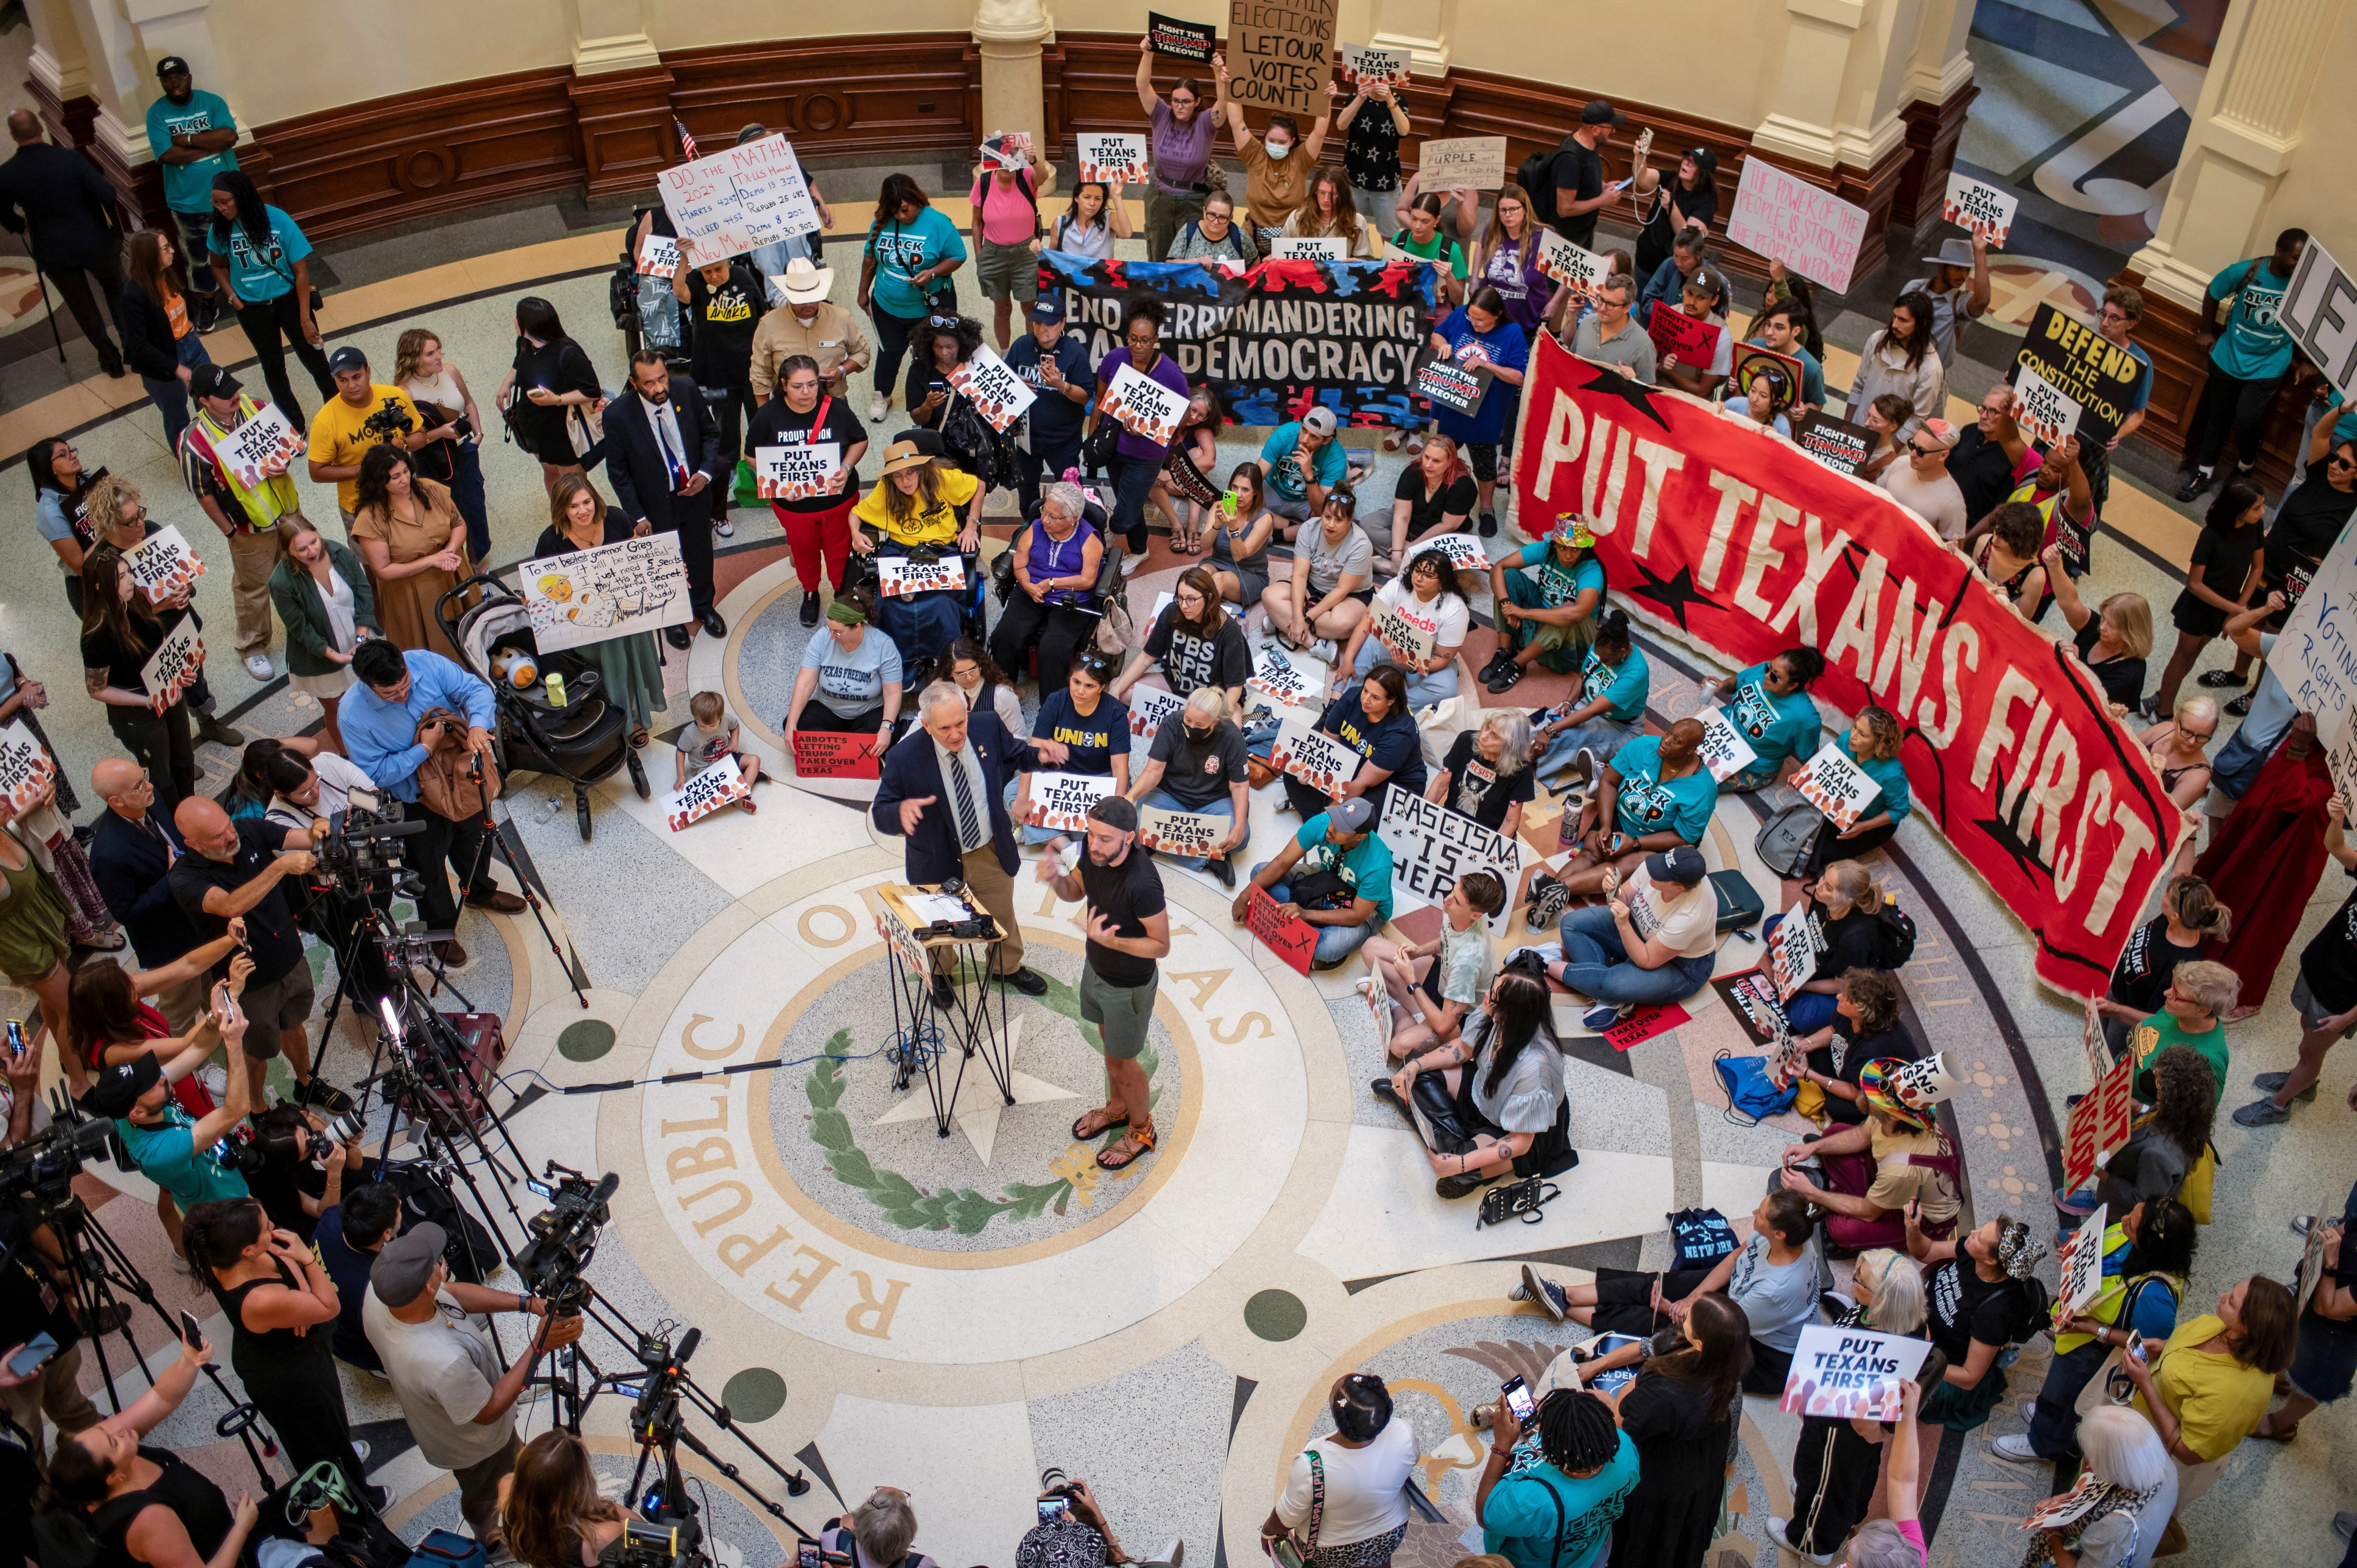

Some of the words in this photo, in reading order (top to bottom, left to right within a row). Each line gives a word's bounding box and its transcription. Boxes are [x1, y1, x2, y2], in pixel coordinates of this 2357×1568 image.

[1159, 23, 1185, 36] FIGHT
[1186, 30, 1205, 40] THE
[1232, 2, 1330, 40] ELECTIONS
[1157, 42, 1205, 58] TAKEOVER
[1242, 32, 1282, 55] LET
[1286, 40, 1326, 65] OUR
[1249, 58, 1318, 90] VOTES
[1230, 77, 1309, 111] COUNT!
[1090, 148, 1136, 158] TEXANS
[1101, 138, 1124, 147] PUT
[1427, 141, 1469, 152] TEXAS
[668, 169, 694, 190] DO
[701, 164, 724, 177] THE
[732, 141, 787, 170] MATH!
[1099, 157, 1131, 167] FIRST
[1453, 165, 1480, 175] Stop
[1480, 153, 1495, 162] not
[683, 183, 716, 202] 2024
[768, 180, 776, 190] 13
[781, 176, 797, 187] 32%
[1973, 186, 1997, 201] PUT
[778, 194, 789, 204] 25
[1747, 162, 1772, 195] THE
[1777, 177, 1818, 219] POWER
[1819, 201, 1837, 225] OF
[1838, 207, 1860, 240] THE
[1958, 191, 2004, 218] TEXANS
[677, 204, 713, 221] HARRIS
[776, 215, 782, 224] 8
[788, 208, 805, 219] 20%
[1962, 203, 1995, 224] FIRST
[686, 221, 719, 239] ALLRED
[782, 226, 794, 237] 30
[799, 222, 814, 231] 80%
[1739, 189, 1786, 226] PEOPLE
[1789, 214, 1799, 235] IS
[1802, 219, 1859, 266] STRONGER
[1771, 226, 1804, 249] THAN
[1550, 246, 1595, 277] TEXANS
[1563, 244, 1586, 261] PUT
[1732, 219, 1751, 246] THE
[1754, 230, 1797, 267] PEOPLE
[1800, 253, 1811, 274] IN
[1813, 257, 1849, 293] POWER
[1554, 259, 1586, 280] FIRST
[1066, 288, 1121, 330] END
[1157, 299, 1424, 341] ERRYMANDERING,
[1177, 334, 1419, 384] DEMOCRACY
[2045, 310, 2138, 385] DEFEND
[992, 364, 1015, 384] PUT
[1429, 361, 1459, 376] FIGHT
[1459, 371, 1479, 386] THE
[2064, 353, 2103, 389] THE
[972, 376, 1005, 406] FIRST
[975, 362, 1017, 406] TEXANS
[1138, 380, 1164, 399] PUT
[1419, 382, 1469, 409] TAKEOVER
[1123, 382, 1171, 417] TEXANS
[1124, 397, 1159, 421] FIRST
[234, 422, 281, 459] TEXANS
[239, 420, 264, 442] PUT
[778, 431, 804, 443] PROUD
[248, 435, 282, 464] FIRST
[784, 451, 812, 461] PUT
[770, 460, 827, 471] TEXANS
[780, 471, 818, 482] FIRST
[524, 564, 541, 576] To
[544, 561, 557, 572] my
[558, 553, 589, 566] bestest
[591, 546, 623, 562] governor
[573, 563, 587, 576] It
[591, 559, 606, 570] will
[612, 556, 624, 565] be
[595, 571, 617, 586] just
[620, 564, 641, 575] need
[647, 558, 655, 570] 5
[595, 581, 612, 593] may
[613, 575, 631, 585] this
[634, 571, 644, 580] be
[647, 568, 660, 576] our
[609, 576, 647, 592] wonderful
[650, 570, 683, 582] secret.
[625, 586, 647, 597] Love
[647, 588, 677, 601] Buddy
[1396, 606, 1436, 632] needs
[1173, 629, 1214, 661] PBS
[822, 666, 844, 678] TEXAS
[844, 668, 872, 683] FREEDOM
[1170, 649, 1211, 682] NPR
[1534, 387, 1684, 560] PUT
[1698, 468, 1980, 750] TEXANS
[1971, 665, 2155, 938] FIRST
[2302, 632, 2348, 712] RIGHTS
[822, 687, 869, 701] NETWORK
[1742, 684, 1774, 729] BLACK
[2297, 680, 2327, 718] ACT
[1290, 736, 1343, 772] TEXANS
[1306, 733, 1335, 751] PUT
[1293, 750, 1332, 776] FIRST
[1470, 762, 1494, 780] RESIST
[1832, 758, 1857, 780] PUT
[675, 770, 728, 807] TEXANS
[685, 772, 711, 795] PUT
[1811, 772, 1845, 802] FIRST
[1816, 759, 1861, 800] TEXANS
[687, 783, 722, 811] FIRST
[1389, 788, 1521, 870] FASCISM
[1418, 835, 1463, 878] IS
[2102, 1054, 2132, 1148] FIGHT
[664, 1012, 912, 1342] REPUBLIC
[1838, 1337, 1885, 1355] PUT
[1813, 1352, 1900, 1374] TEXANS
[1819, 1371, 1880, 1390] FIRST
[1313, 1459, 1323, 1498] ALPHA
[1311, 1502, 1323, 1531] KAPPA
